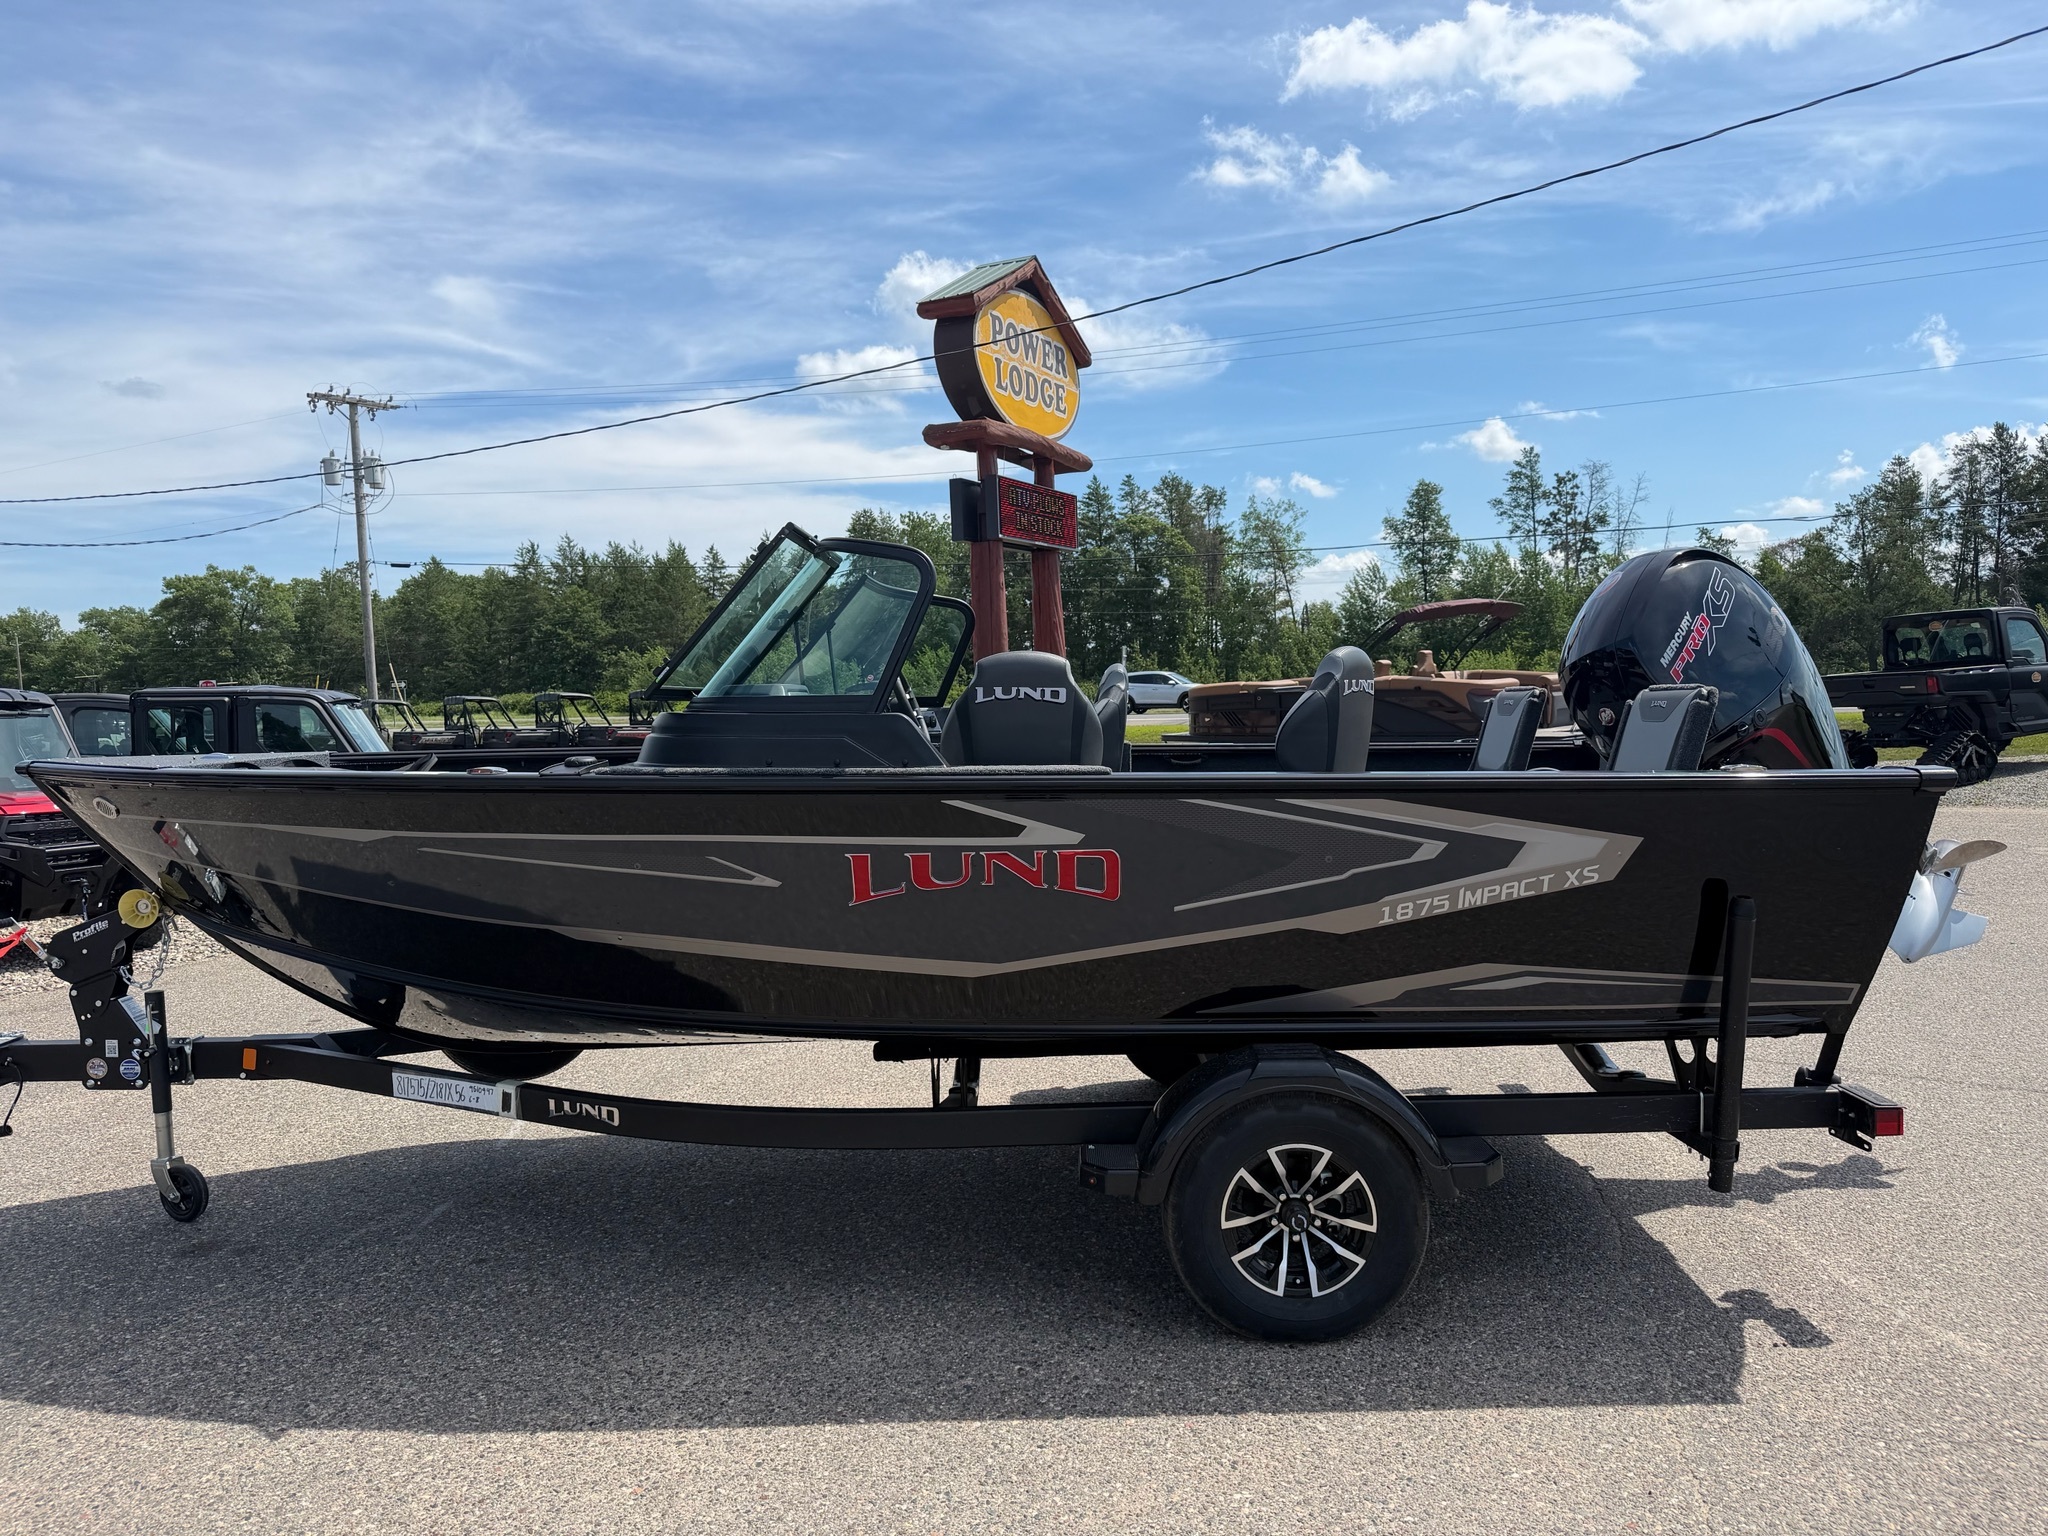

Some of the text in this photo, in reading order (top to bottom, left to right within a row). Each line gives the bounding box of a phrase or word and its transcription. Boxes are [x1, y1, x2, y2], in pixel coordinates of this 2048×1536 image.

[989, 311, 1068, 380] POWER
[994, 356, 1068, 416] LODGE
[1008, 486, 1030, 508] ATV
[1015, 511, 1064, 538] IN STOCK
[1659, 610, 1694, 669] MERCURY
[974, 686, 1067, 704] LUND
[844, 848, 1122, 907] LUND
[1377, 864, 1601, 925] 1875 IMPACT XS
[72, 919, 109, 942] Profile
[547, 1098, 620, 1128] LUND
